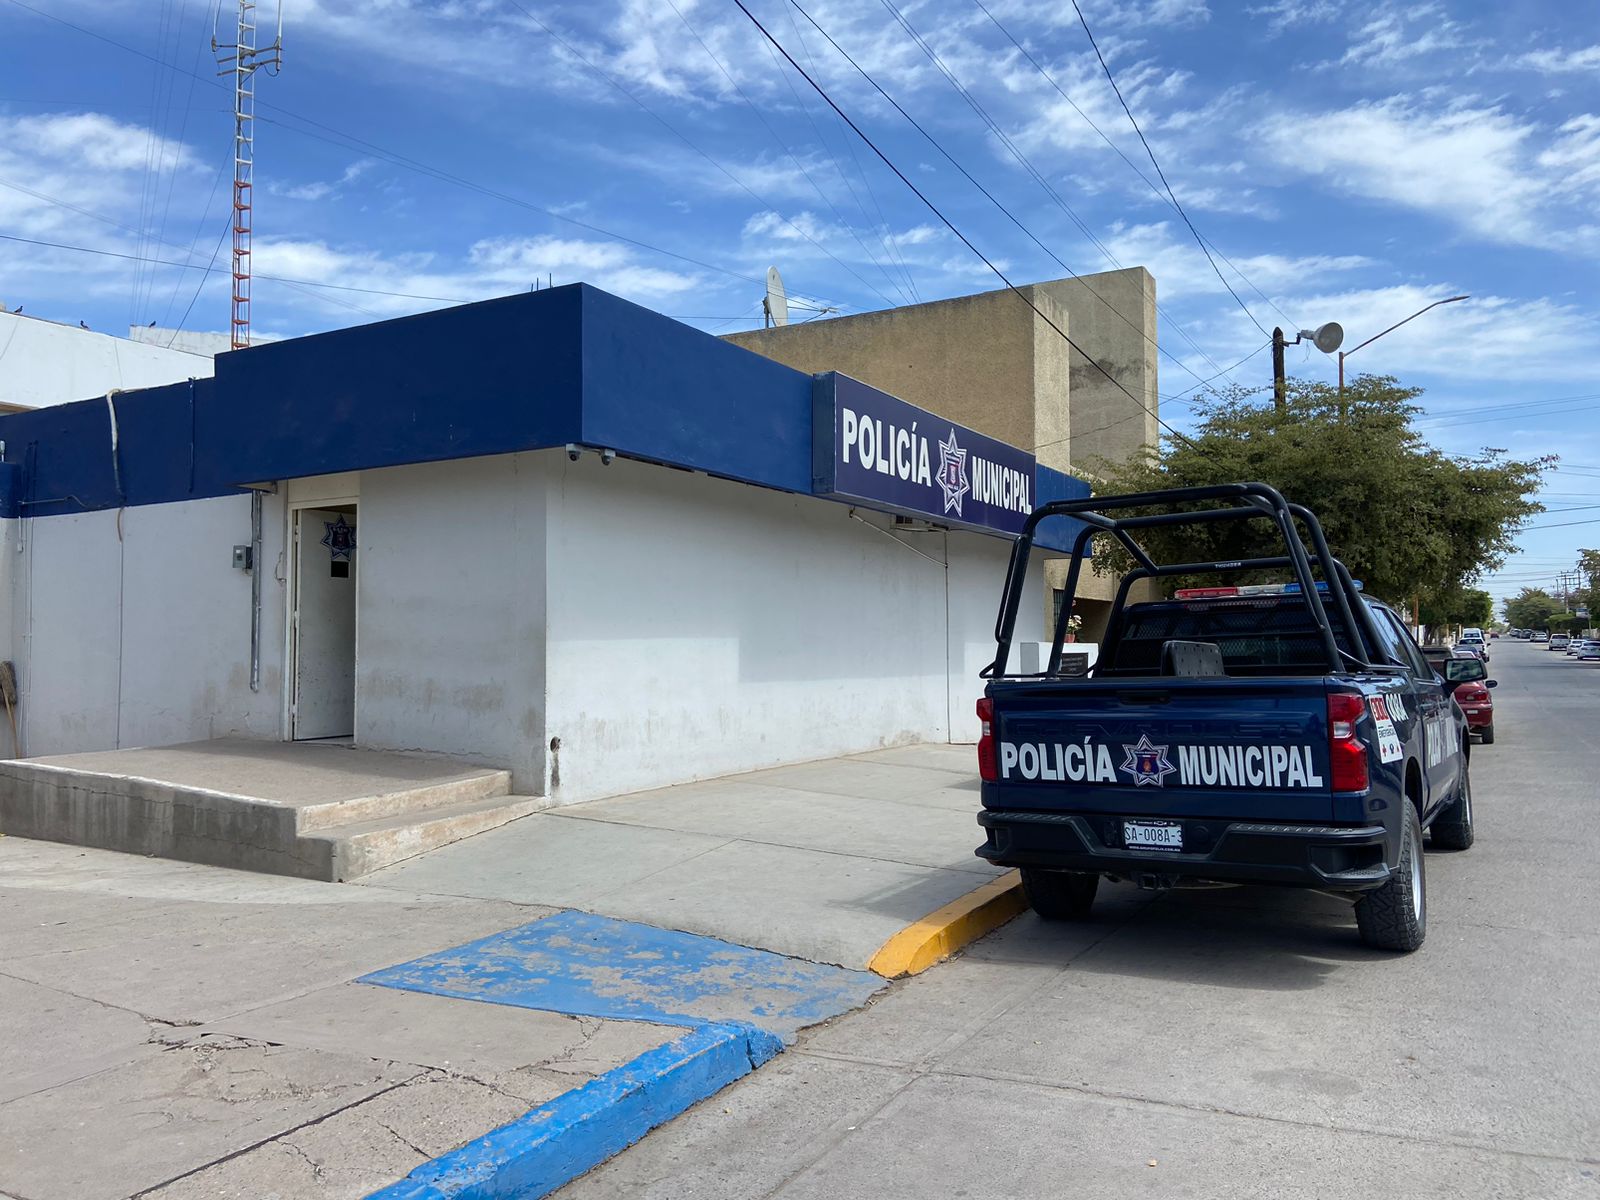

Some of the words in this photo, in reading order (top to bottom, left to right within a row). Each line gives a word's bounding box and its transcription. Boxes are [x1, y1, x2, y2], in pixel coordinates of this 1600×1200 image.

[843, 407, 932, 487] POLICÍA
[972, 455, 1032, 514] MUNICIPAL
[1000, 736, 1118, 783] POLICÍA
[1178, 745, 1323, 788] MUNICIPAL
